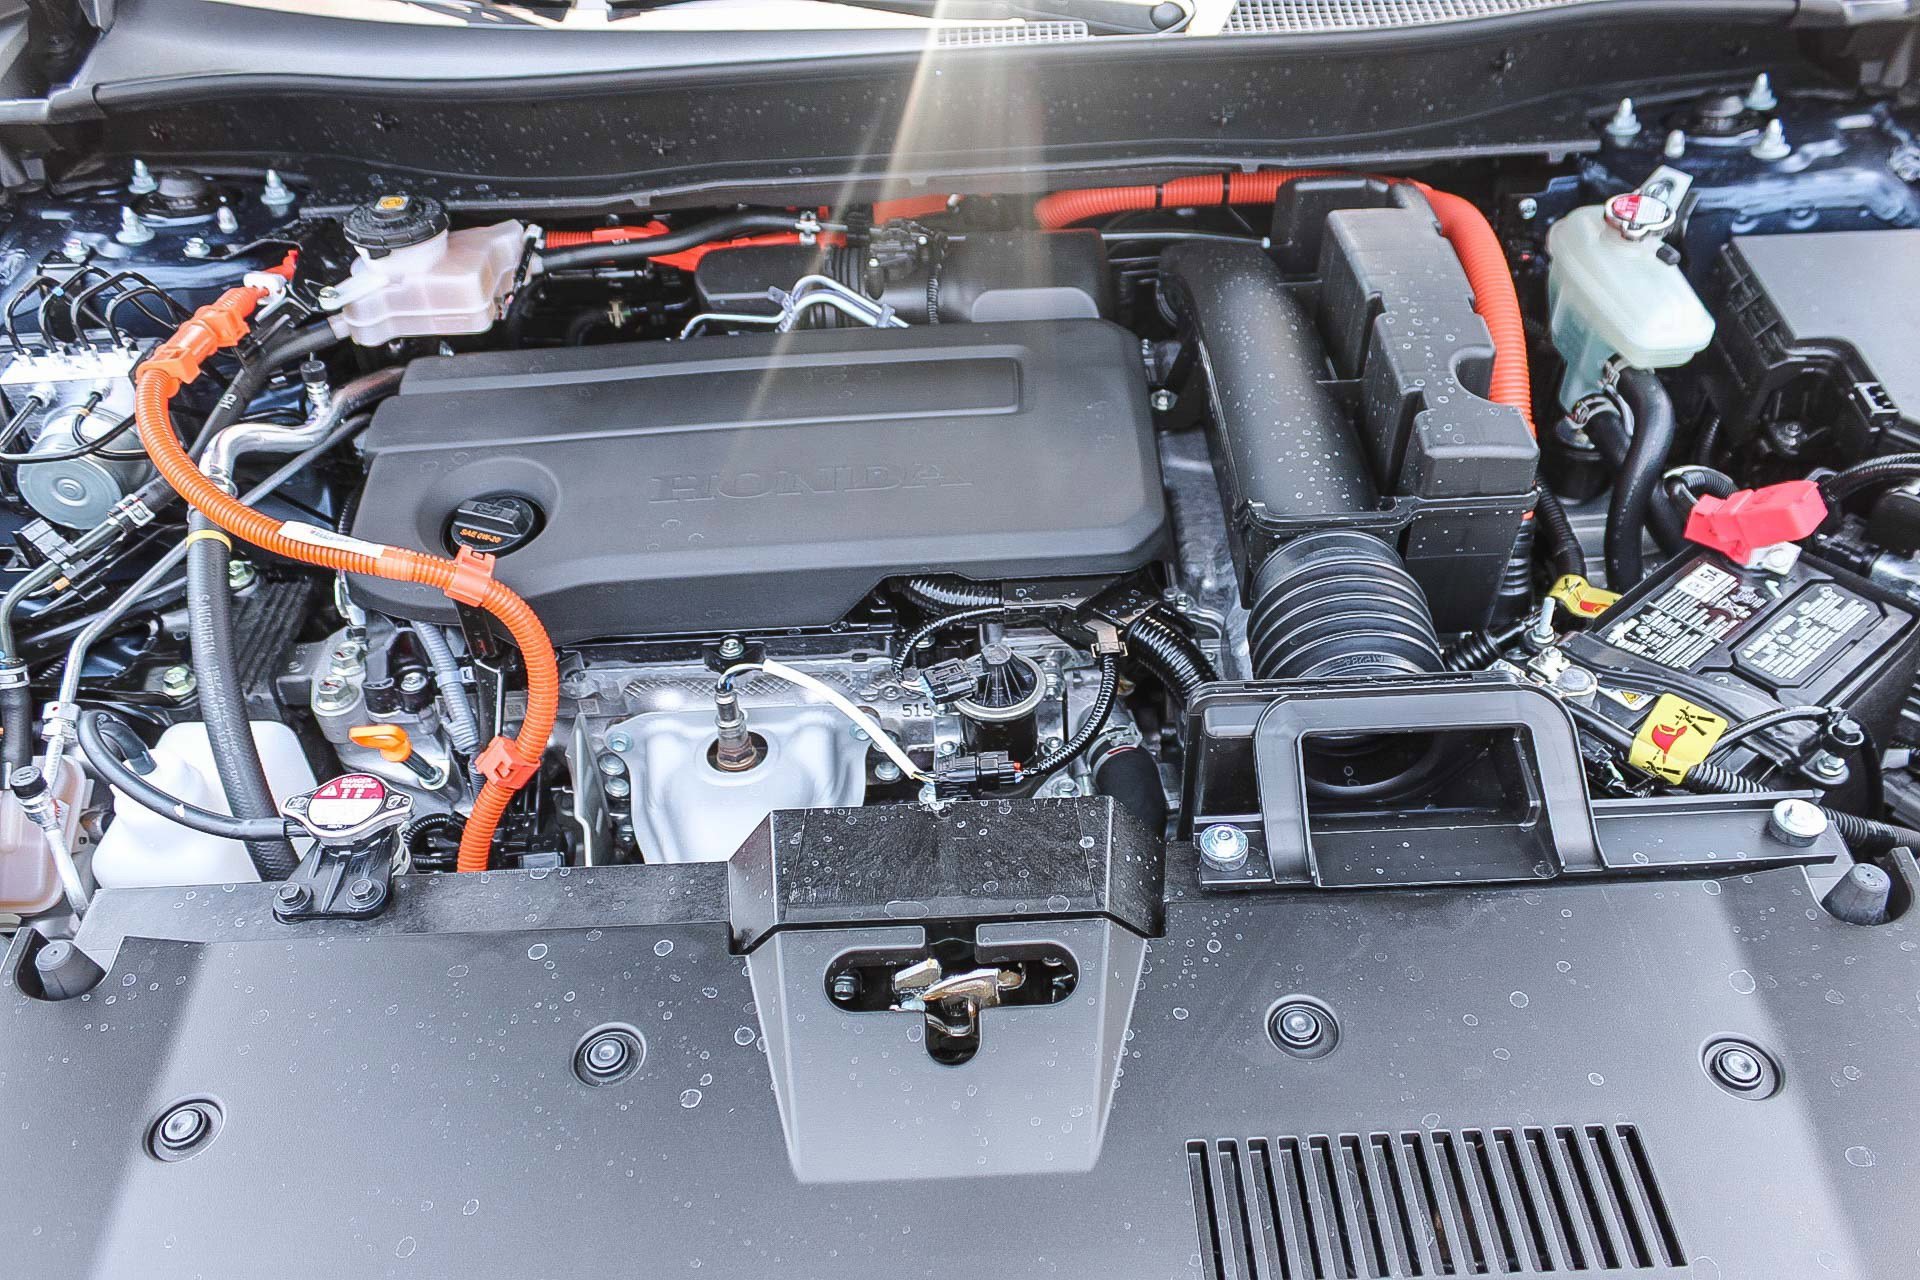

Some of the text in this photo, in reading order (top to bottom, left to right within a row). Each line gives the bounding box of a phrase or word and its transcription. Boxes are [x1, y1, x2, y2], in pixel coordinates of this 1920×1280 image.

[648, 464, 974, 504] HONDA
[459, 528, 503, 544] SAE 0W-20
